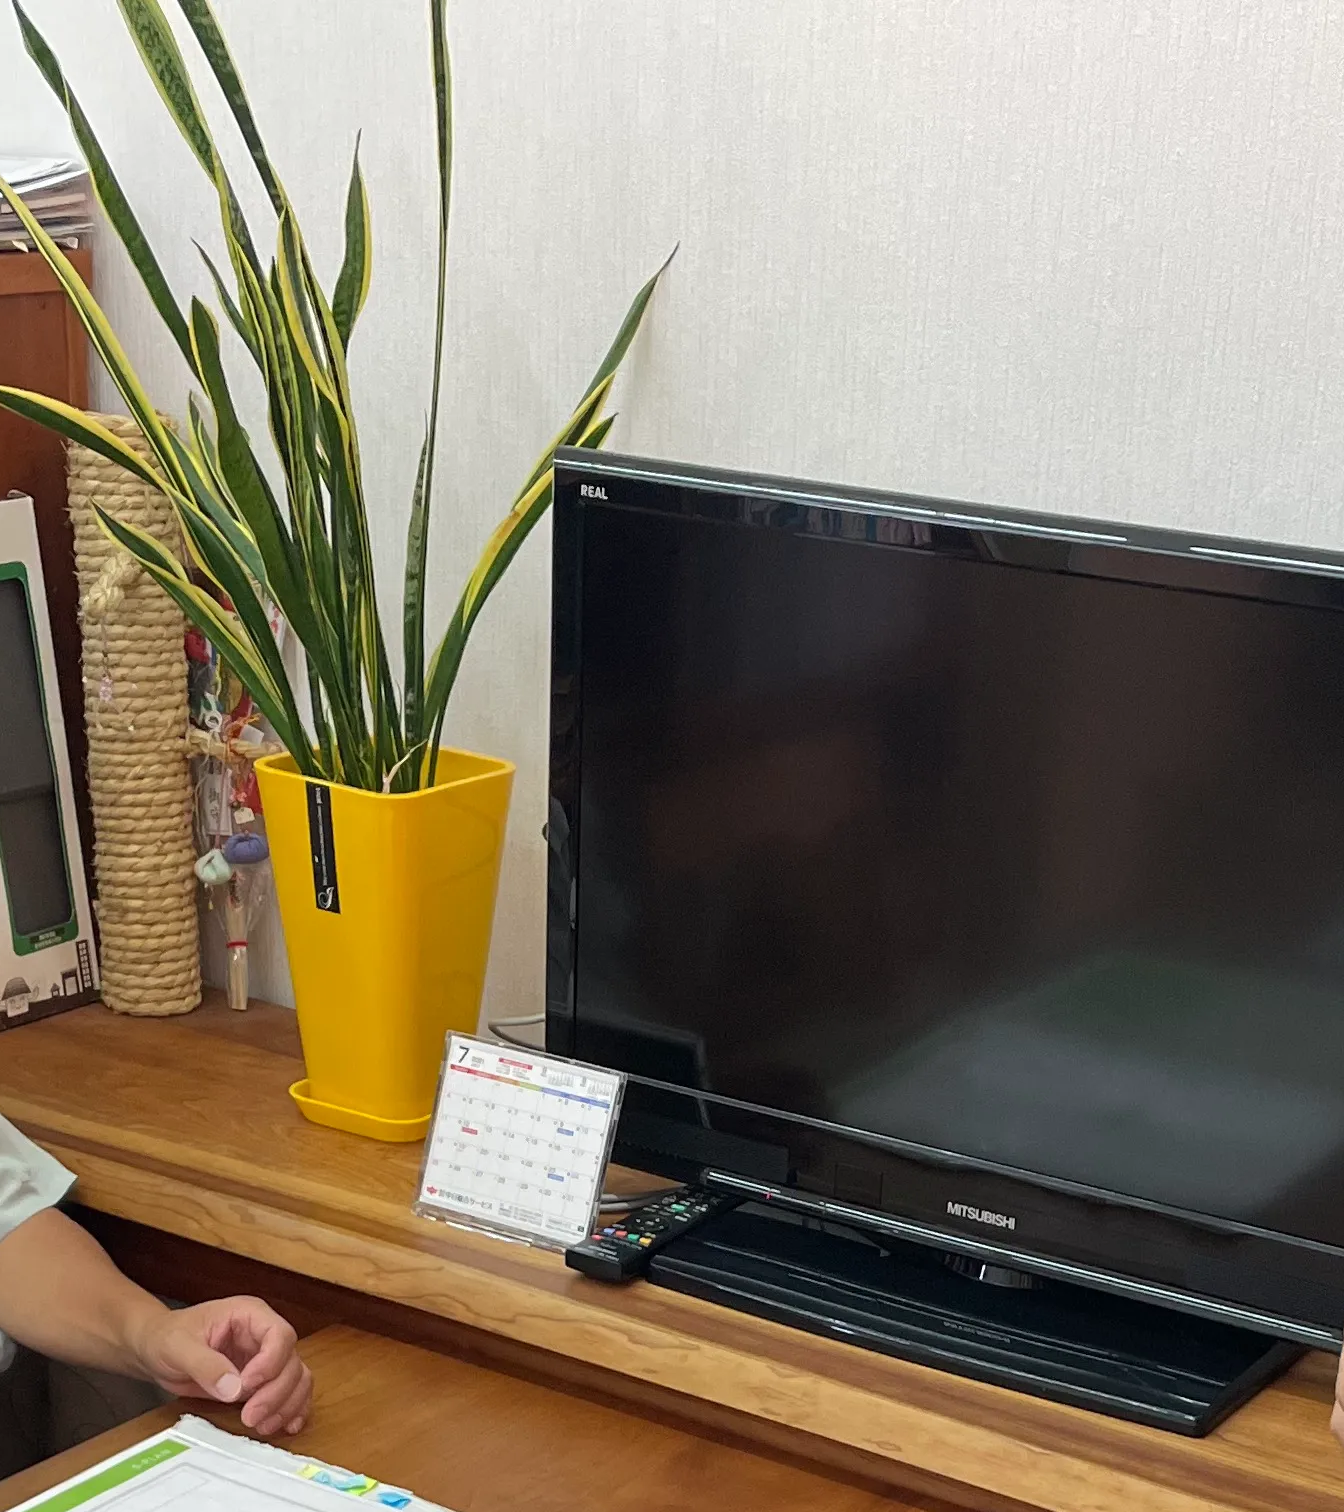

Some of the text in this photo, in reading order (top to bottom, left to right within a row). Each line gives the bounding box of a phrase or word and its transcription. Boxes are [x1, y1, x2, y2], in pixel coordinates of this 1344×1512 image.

[580, 484, 608, 500] REAL
[458, 1046, 470, 1064] 7
[946, 1201, 1016, 1231] MITSUBISHI
